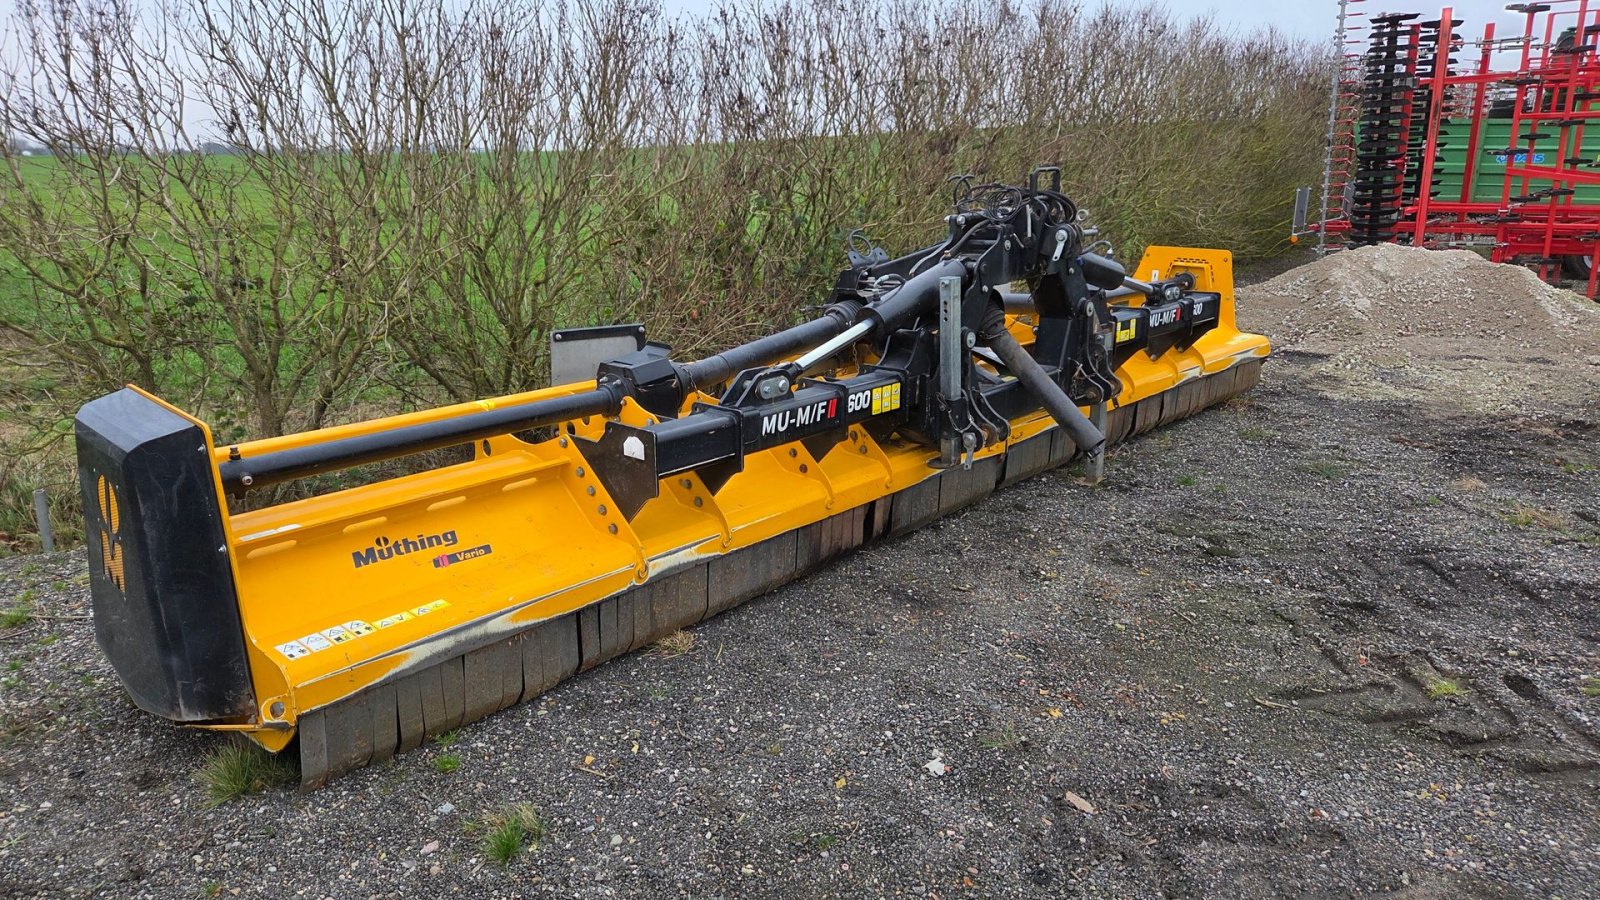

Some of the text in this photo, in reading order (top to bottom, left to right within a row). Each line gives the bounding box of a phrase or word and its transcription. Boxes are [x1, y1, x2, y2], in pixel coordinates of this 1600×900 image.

[847, 389, 871, 413] 600
[351, 530, 459, 568] Müthing
[455, 548, 485, 561] Vario
